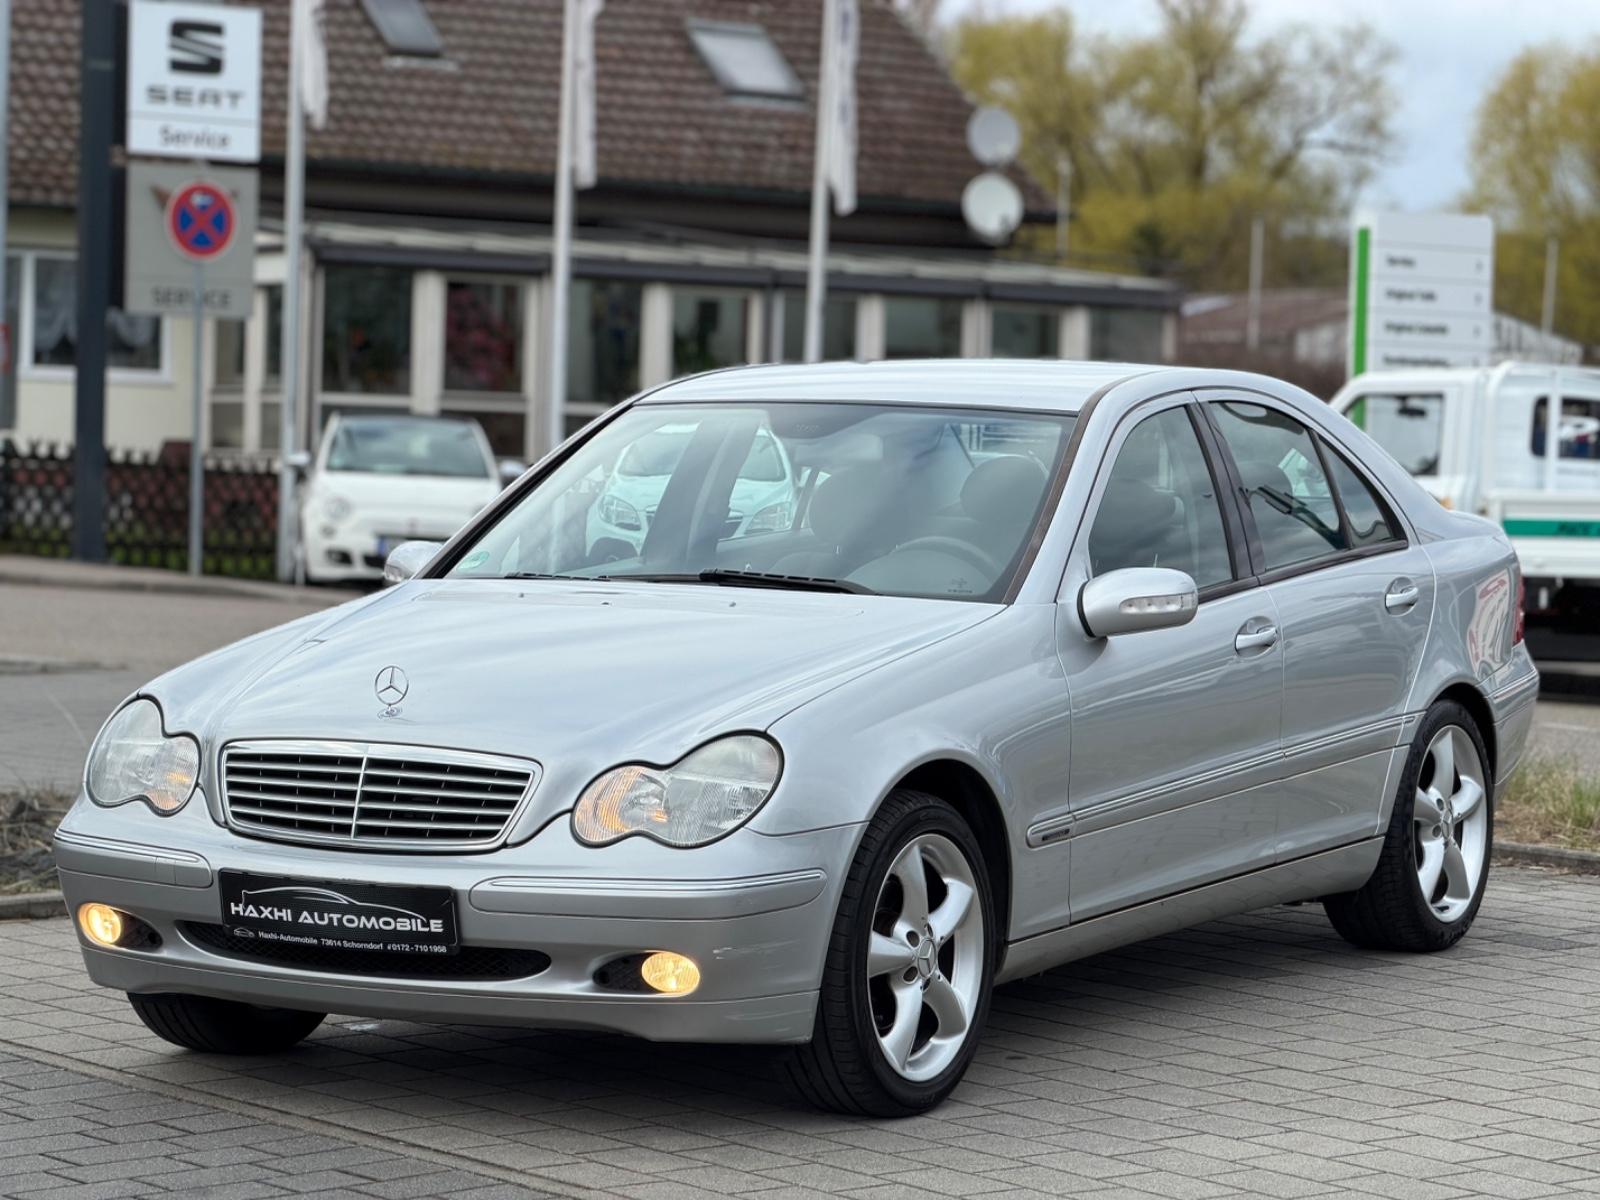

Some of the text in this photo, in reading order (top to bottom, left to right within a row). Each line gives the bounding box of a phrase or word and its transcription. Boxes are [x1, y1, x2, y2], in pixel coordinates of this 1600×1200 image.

[147, 85, 246, 109] SEAT
[160, 126, 230, 149] Service
[230, 902, 444, 933] HAXHI AUTOMOBILE
[258, 931, 318, 945] Haxhi-Automobile
[343, 940, 384, 950] Schorndorf
